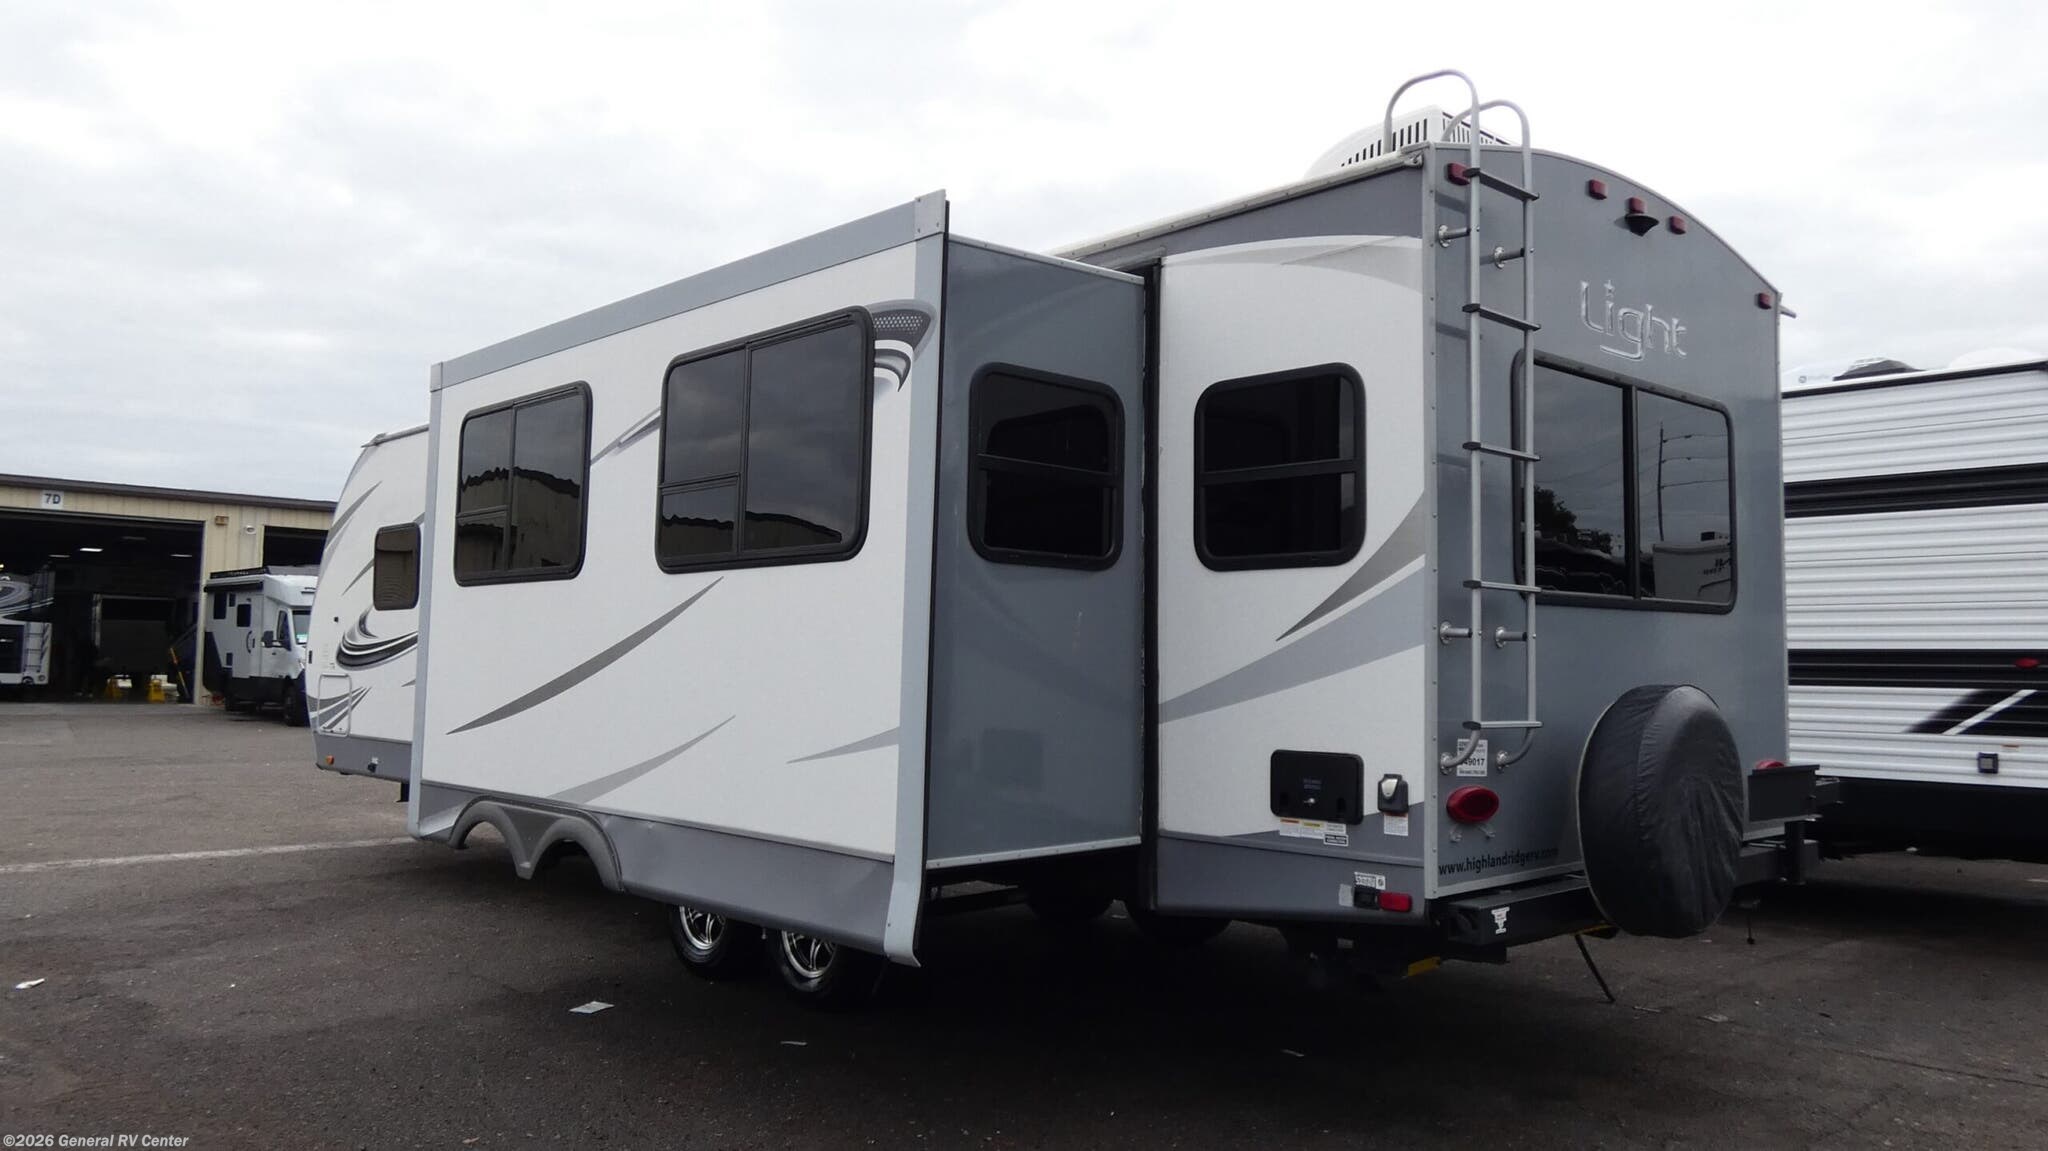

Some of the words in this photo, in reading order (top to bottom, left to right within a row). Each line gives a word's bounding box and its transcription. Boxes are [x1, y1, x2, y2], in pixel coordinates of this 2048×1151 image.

[1581, 280, 1687, 361] Light
[44, 493, 61, 505] 7D
[1438, 847, 1559, 875] www.highlandridgerv.com
